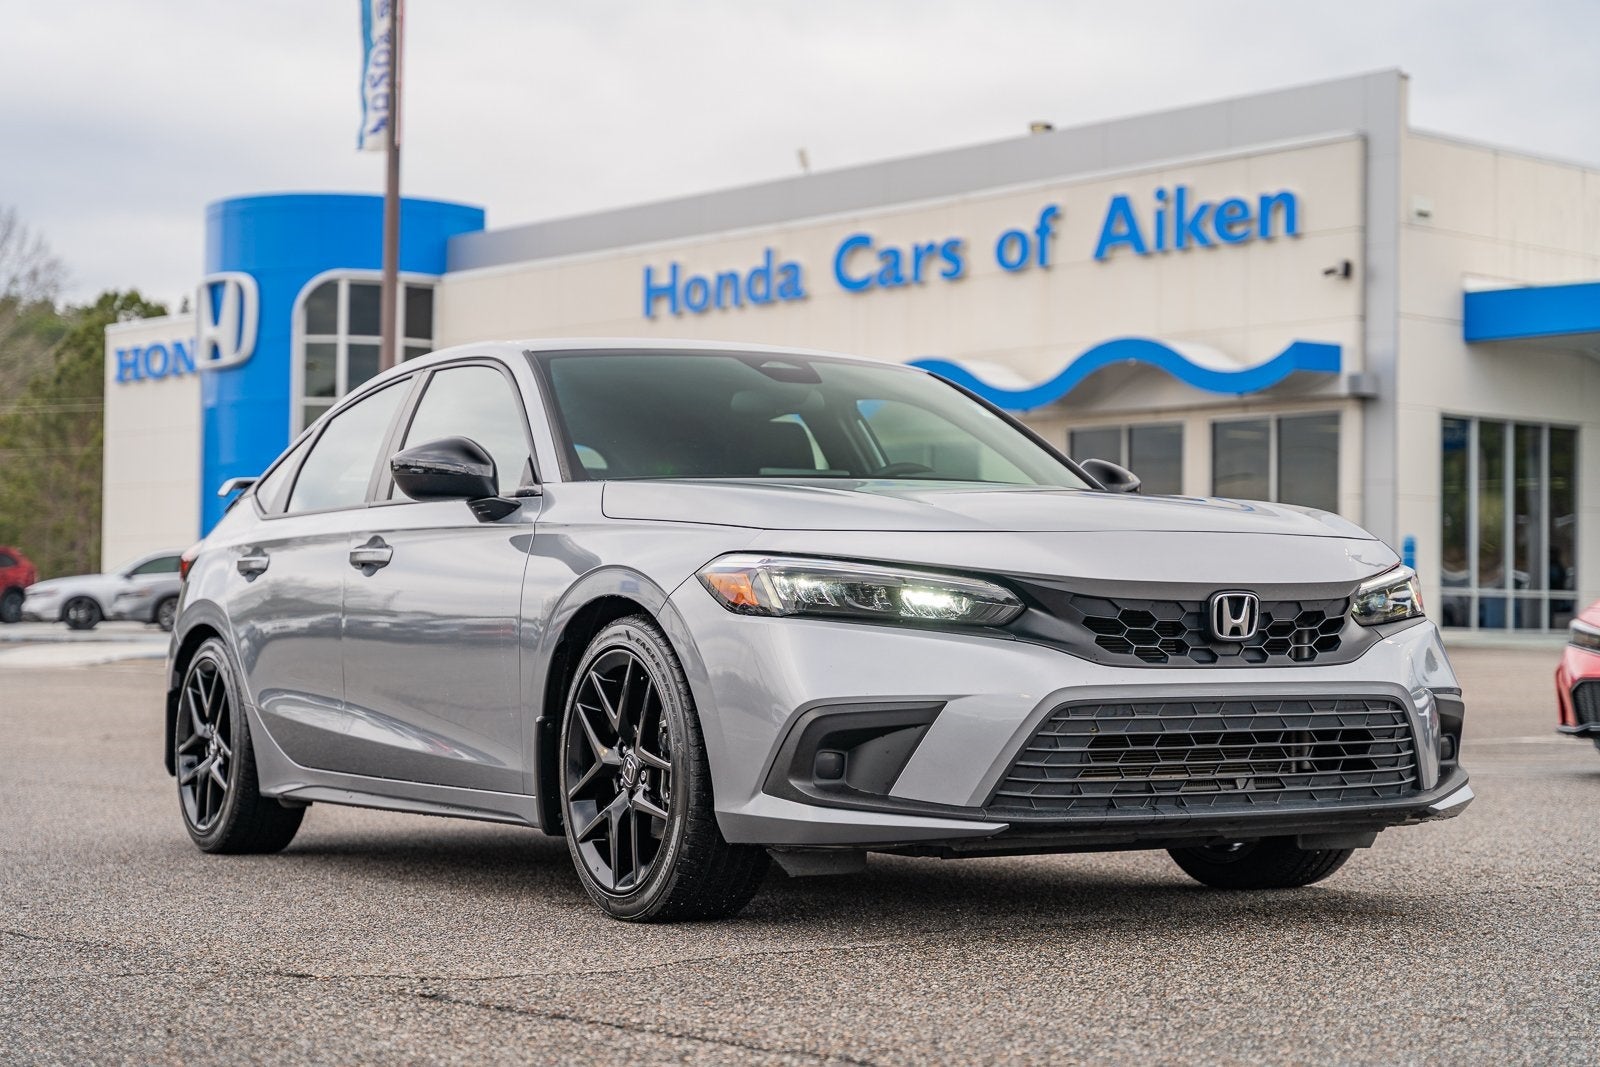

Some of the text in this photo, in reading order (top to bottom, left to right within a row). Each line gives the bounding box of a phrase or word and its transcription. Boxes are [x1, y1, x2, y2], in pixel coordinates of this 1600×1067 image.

[643, 185, 1299, 317] Honda Cars of Aiken
